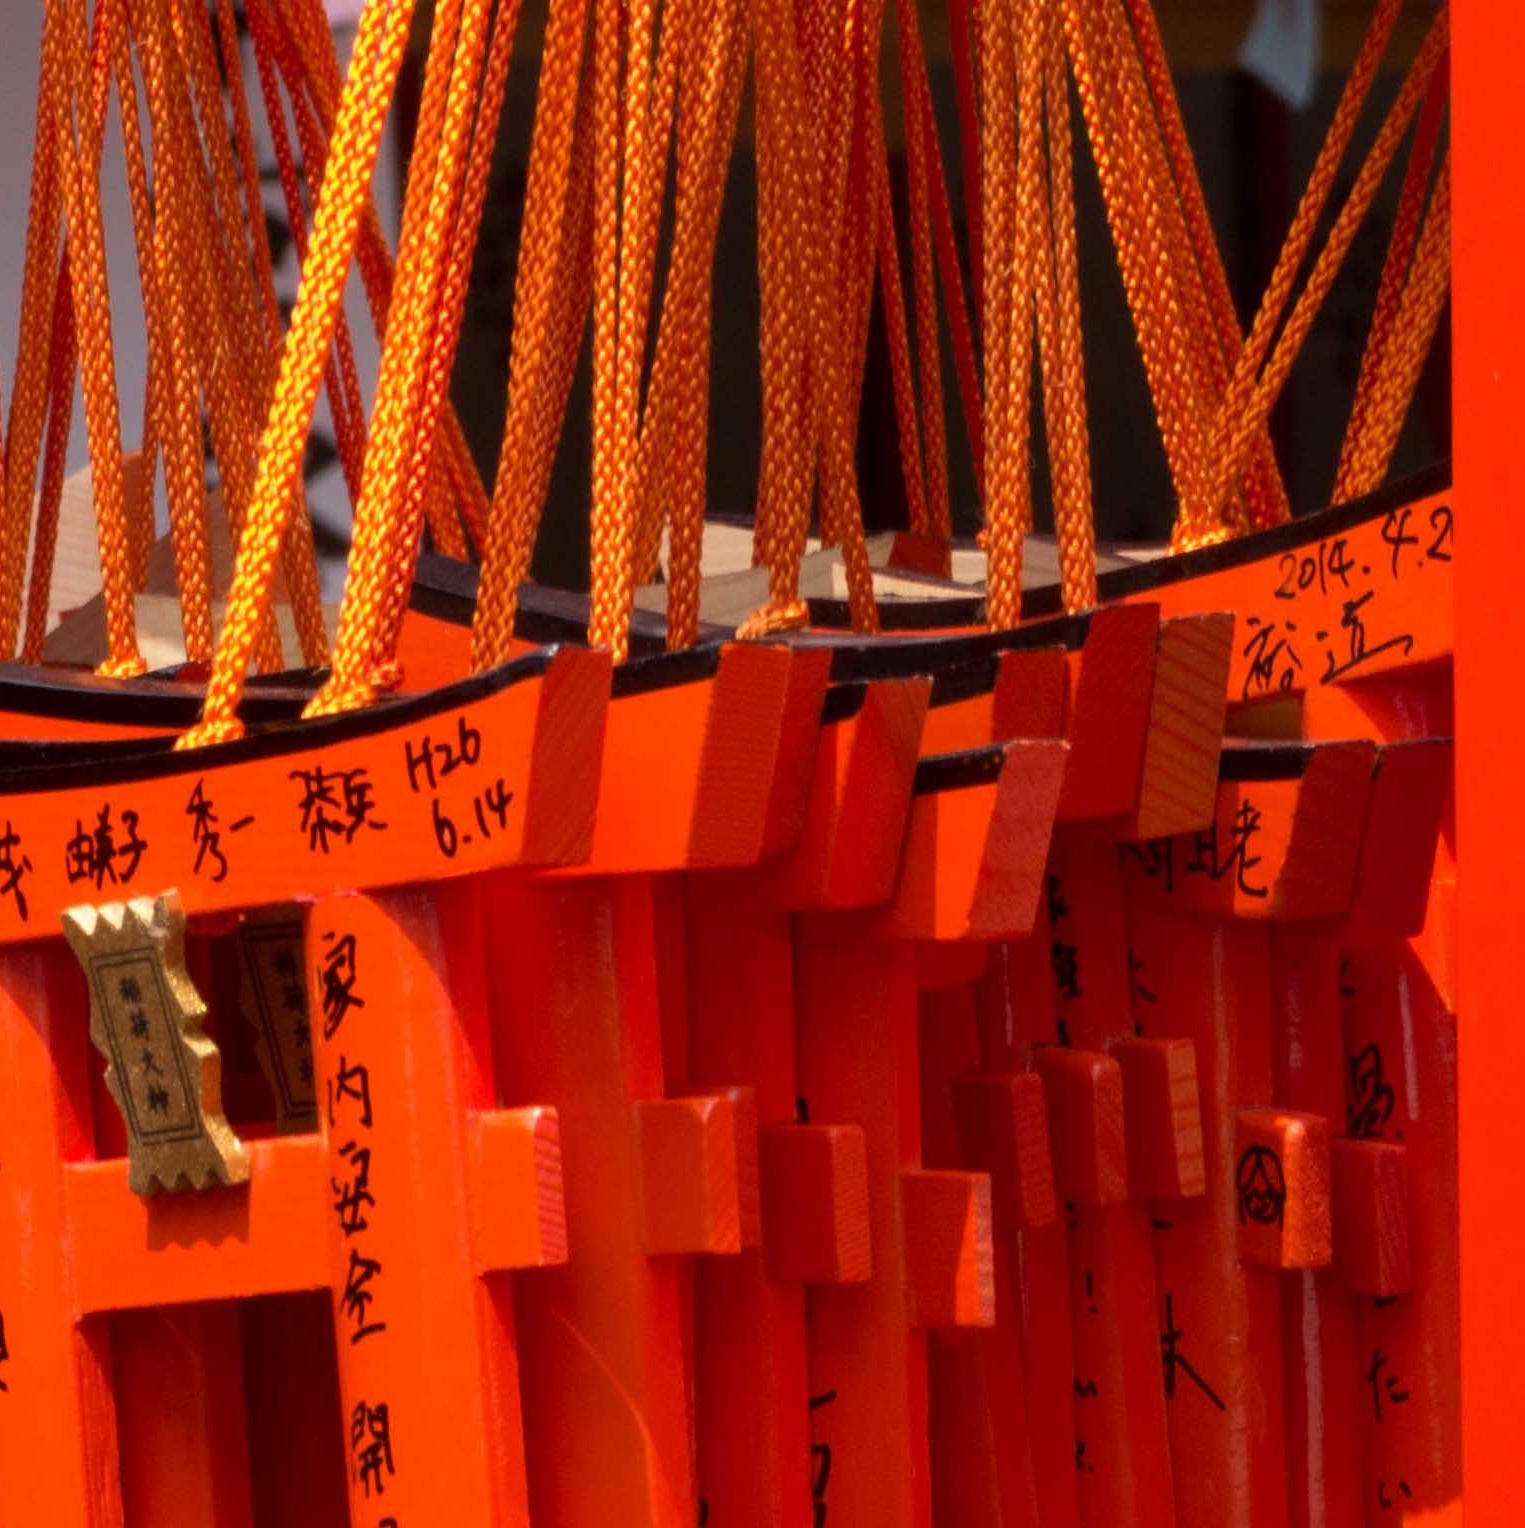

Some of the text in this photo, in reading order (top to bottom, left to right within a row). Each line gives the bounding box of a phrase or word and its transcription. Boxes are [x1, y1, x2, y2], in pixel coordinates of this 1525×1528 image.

[405, 717, 481, 793] H26
[432, 778, 514, 858] 6.14
[320, 930, 387, 1344] 家内安全
